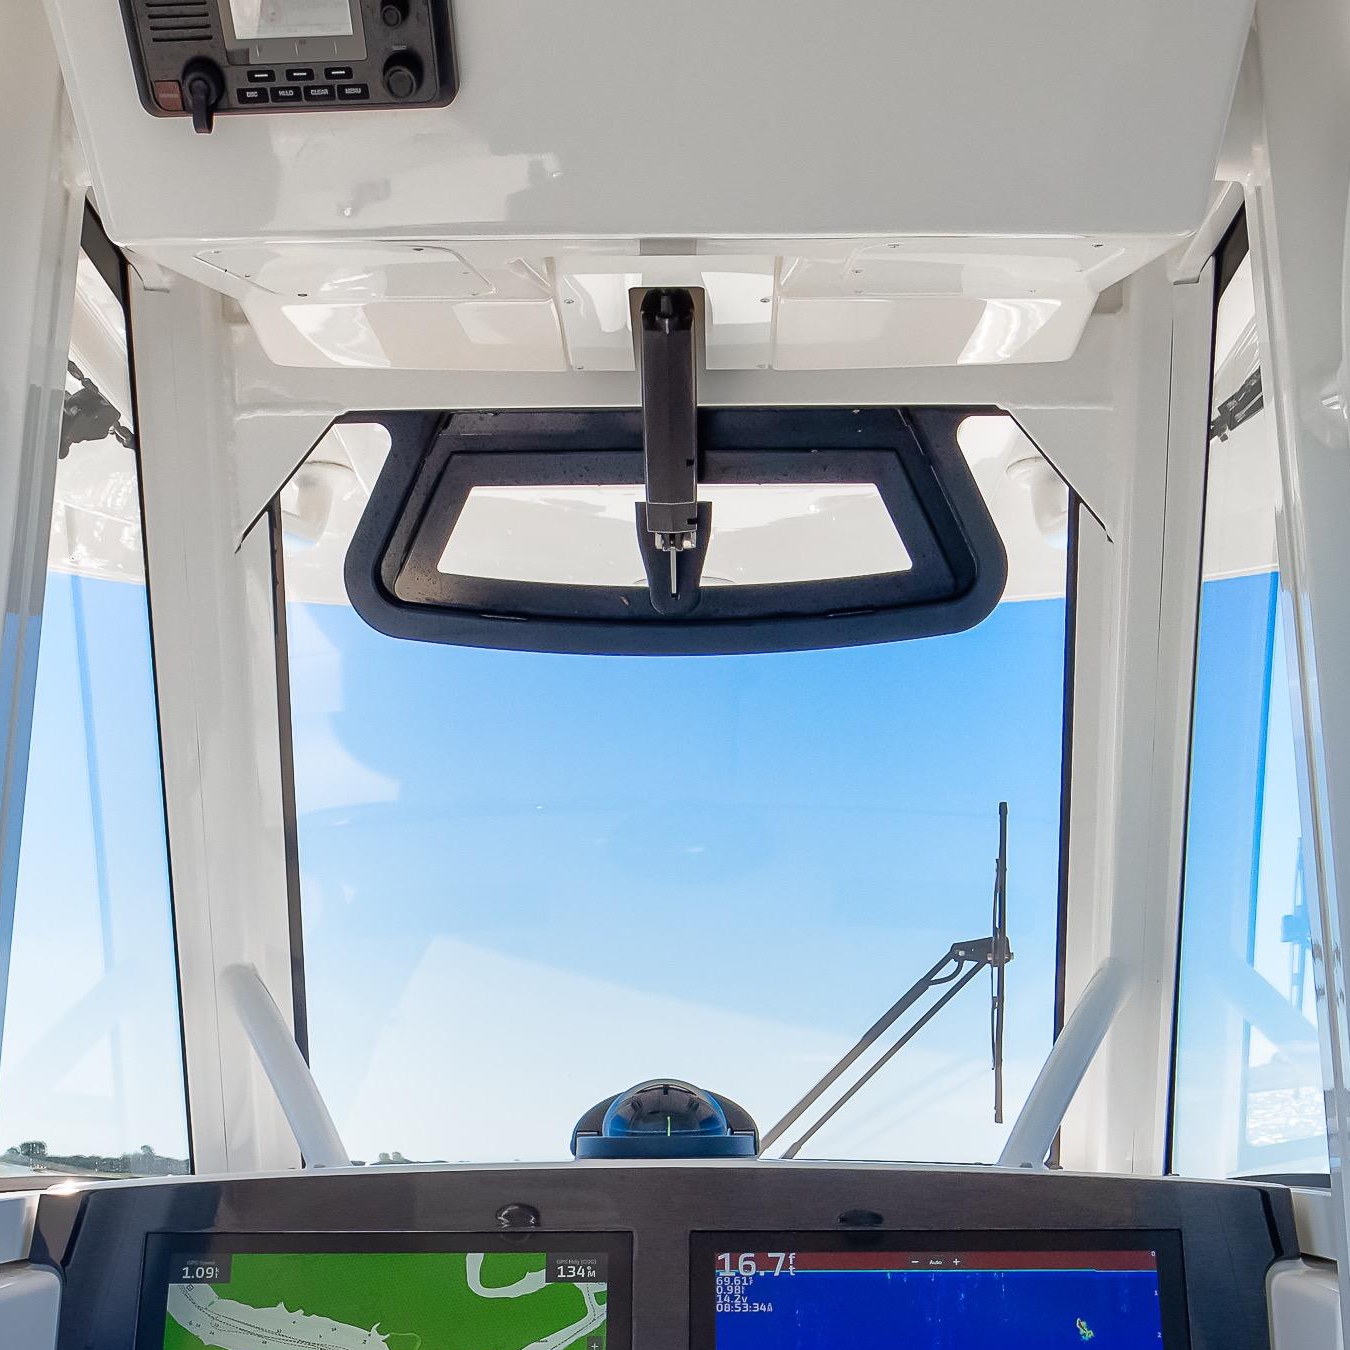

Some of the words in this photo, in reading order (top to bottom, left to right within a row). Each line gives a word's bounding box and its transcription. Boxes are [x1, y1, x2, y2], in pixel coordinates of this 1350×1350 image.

[717, 1252, 786, 1277] 16.7
[182, 1266, 214, 1279] 1.09
[557, 1265, 586, 1278] 134
[716, 1286, 741, 1294] 0.98
